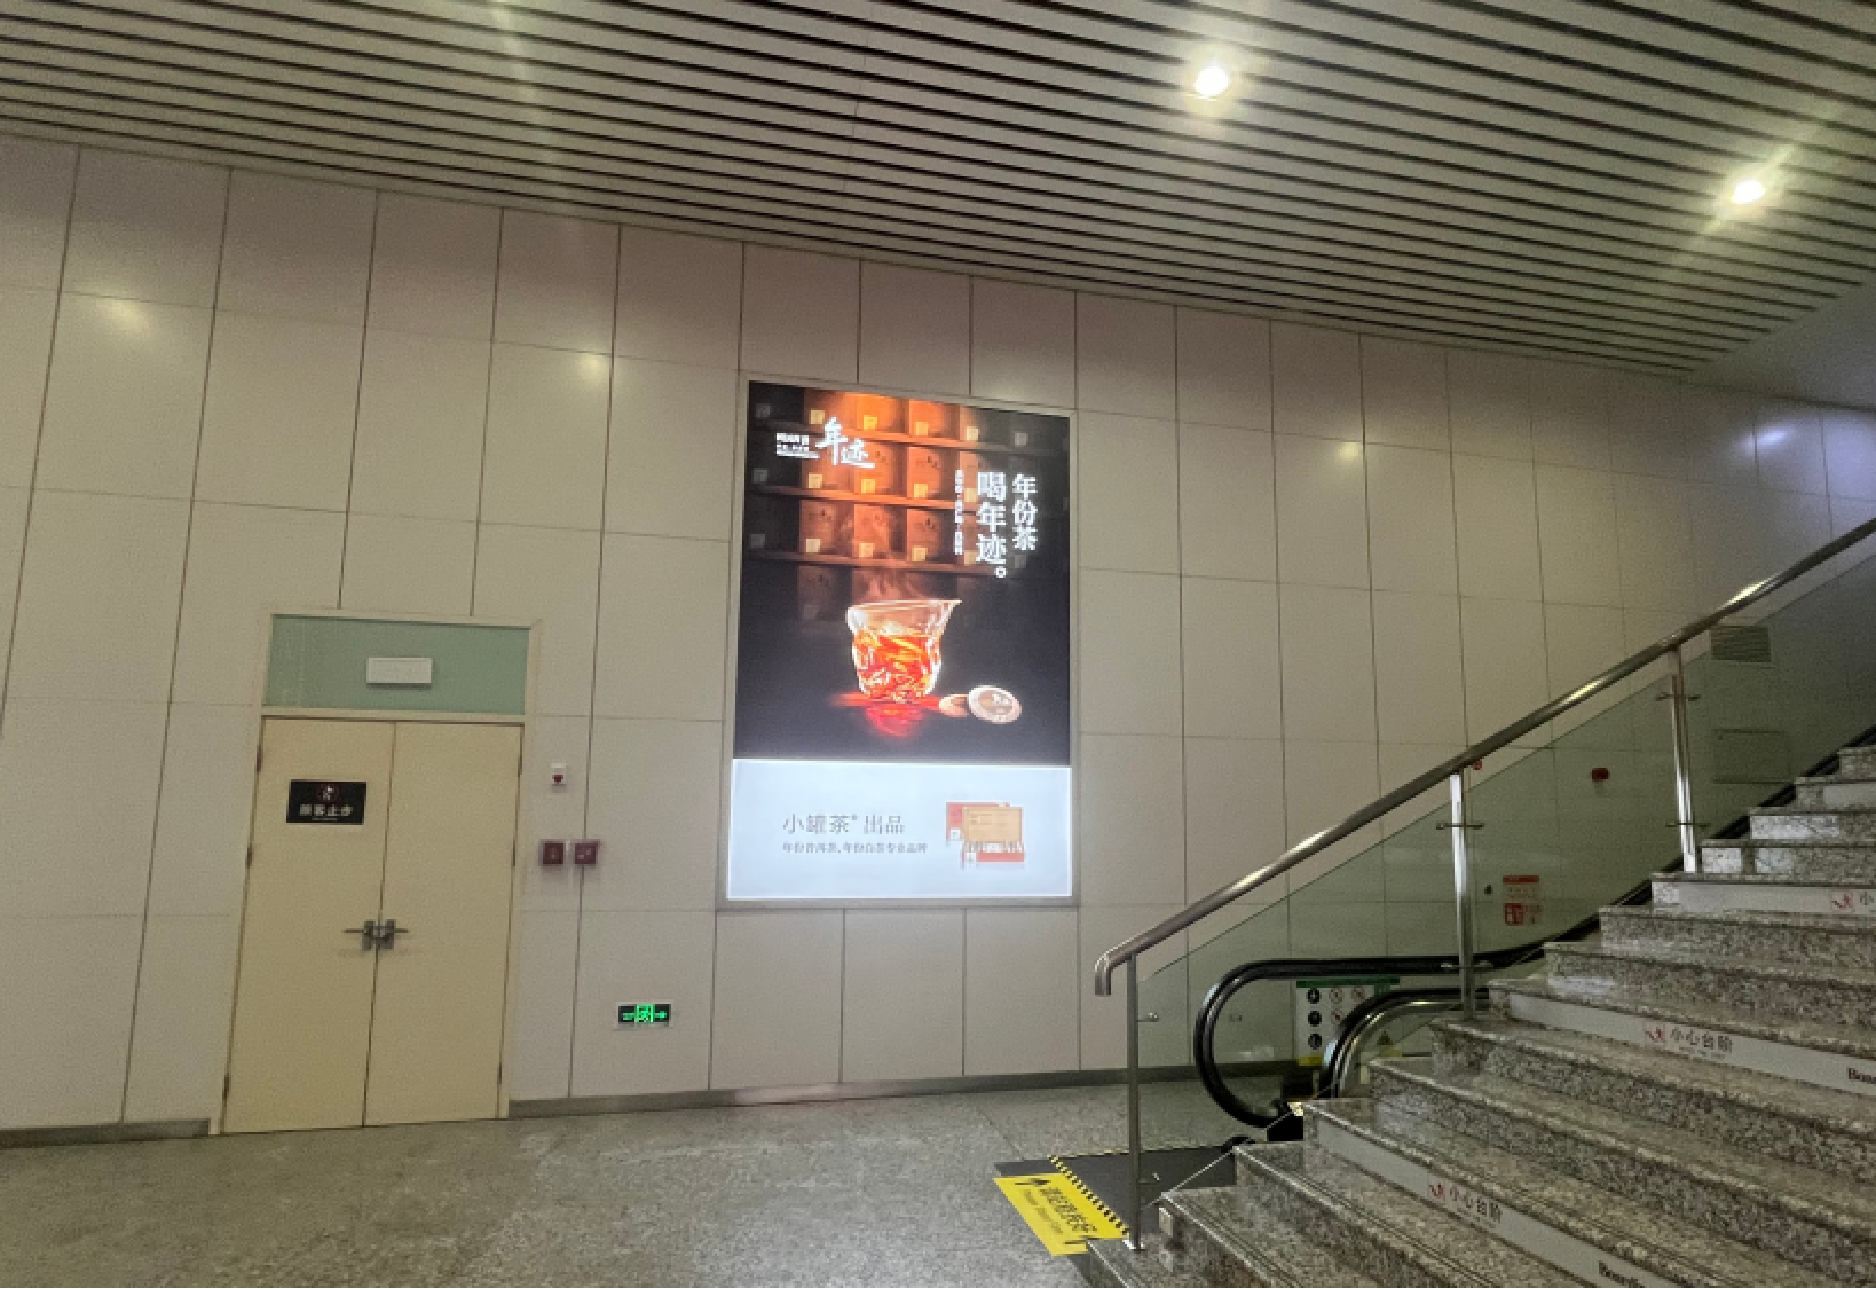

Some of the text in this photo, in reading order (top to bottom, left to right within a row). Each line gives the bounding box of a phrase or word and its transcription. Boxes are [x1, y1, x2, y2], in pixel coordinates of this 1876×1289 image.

[977, 470, 1007, 578] 喝年迹。
[1011, 472, 1038, 551] 年份茶
[863, 813, 906, 834] 出品
[1669, 1026, 1734, 1054] 小心台阶
[1448, 1186, 1503, 1224] 小心台阶
